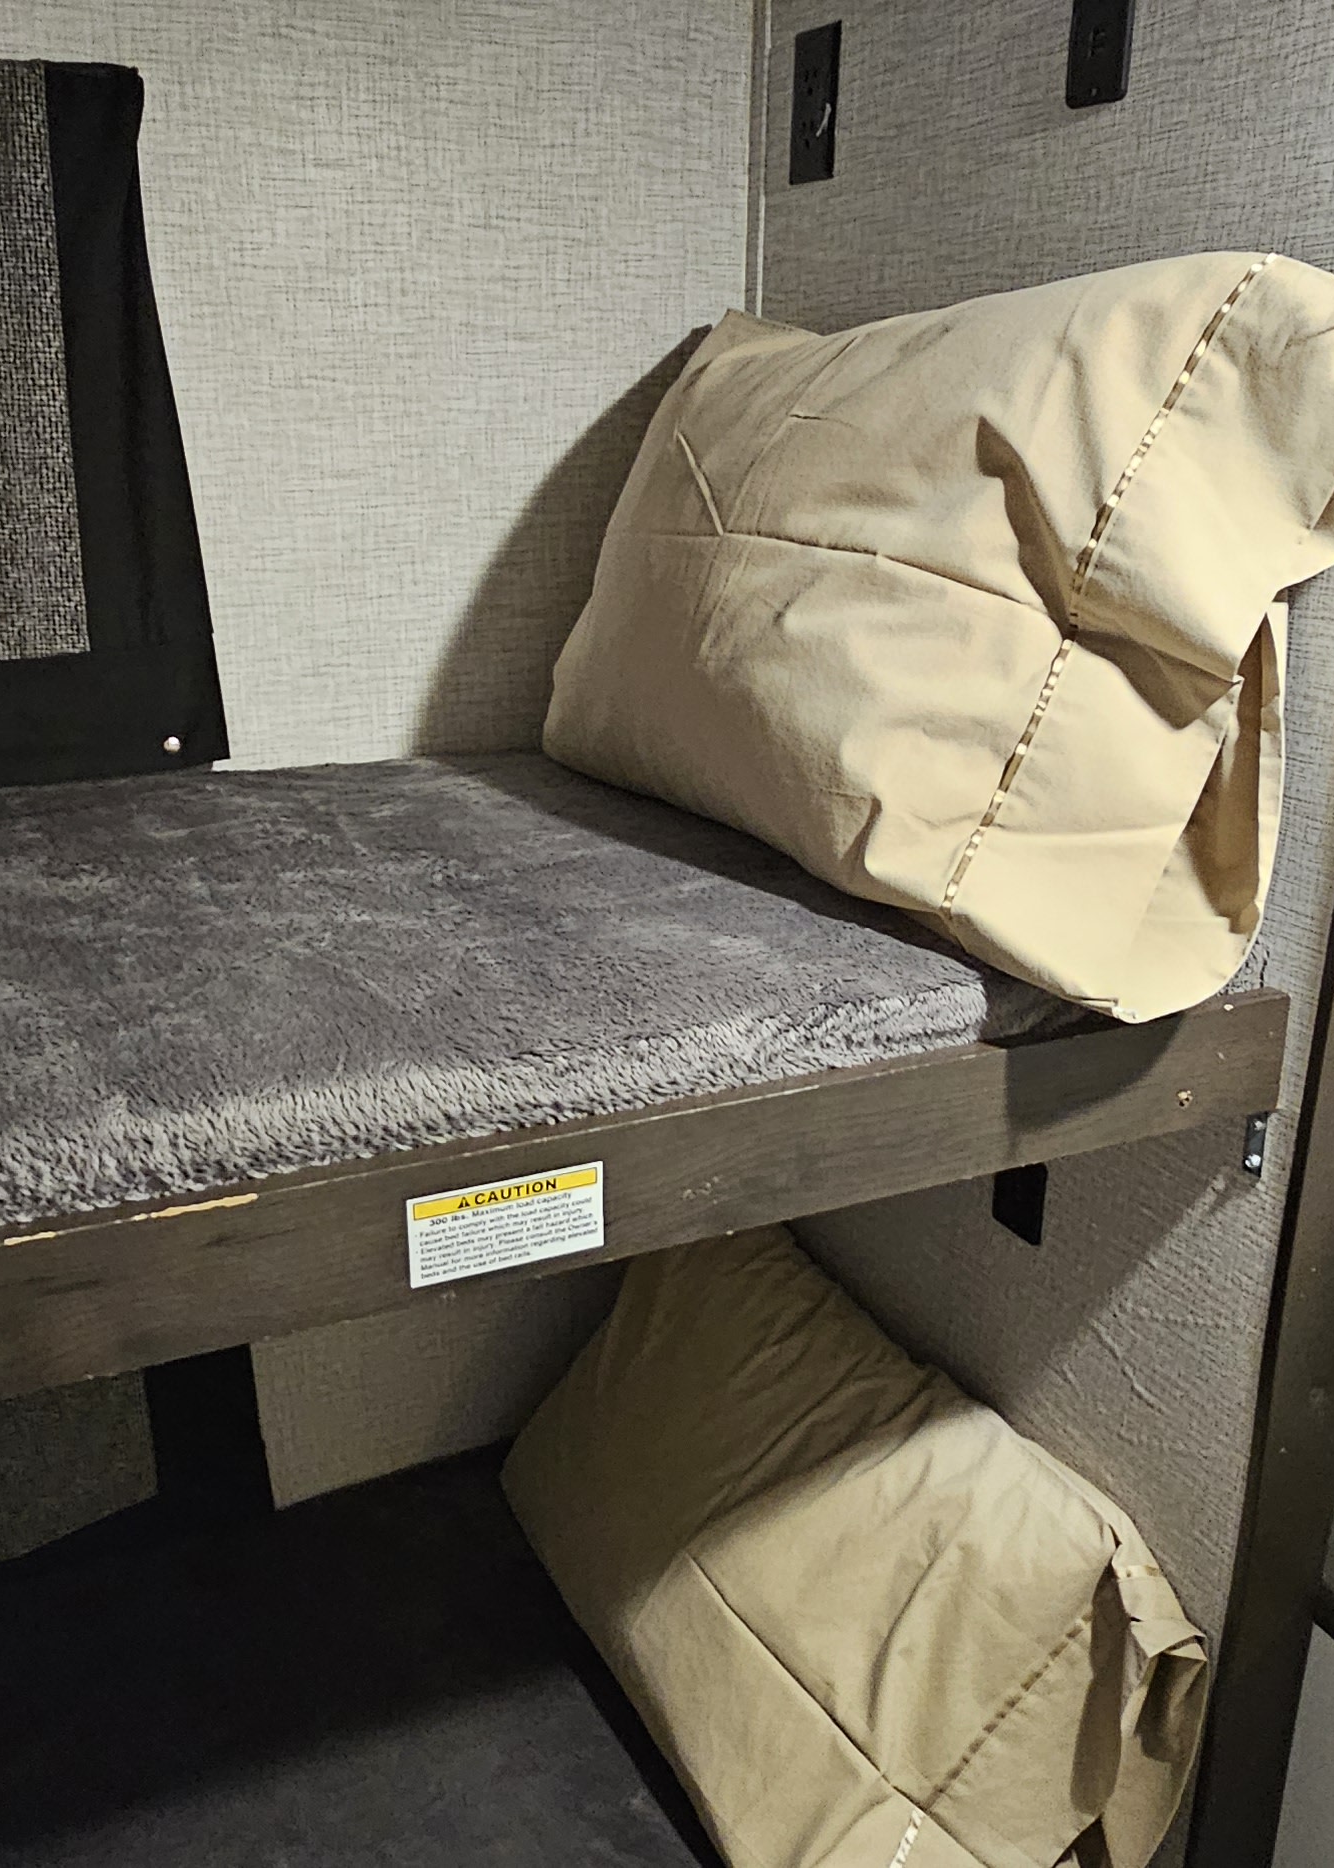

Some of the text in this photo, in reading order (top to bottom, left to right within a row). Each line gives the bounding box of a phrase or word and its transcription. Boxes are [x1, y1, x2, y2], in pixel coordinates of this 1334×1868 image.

[474, 1178, 556, 1205] CAUTION
[420, 1229, 446, 1238] Failure
[459, 1220, 486, 1230] comply
[490, 1215, 504, 1223] with
[539, 1203, 569, 1213] capacity
[430, 1217, 448, 1226] 300
[472, 1205, 514, 1218] Maximum
[516, 1199, 534, 1208] load
[537, 1192, 571, 1204] capacity
[421, 1242, 454, 1255] Elevated
[456, 1239, 474, 1247] beds
[496, 1227, 523, 1240] present
[445, 1233, 459, 1241] bed
[462, 1229, 485, 1237] failure
[489, 1222, 510, 1232] which
[499, 1237, 523, 1246] Please
[486, 1244, 528, 1257] information
[531, 1236, 565, 1247] regarding
[421, 1271, 440, 1279] beds
